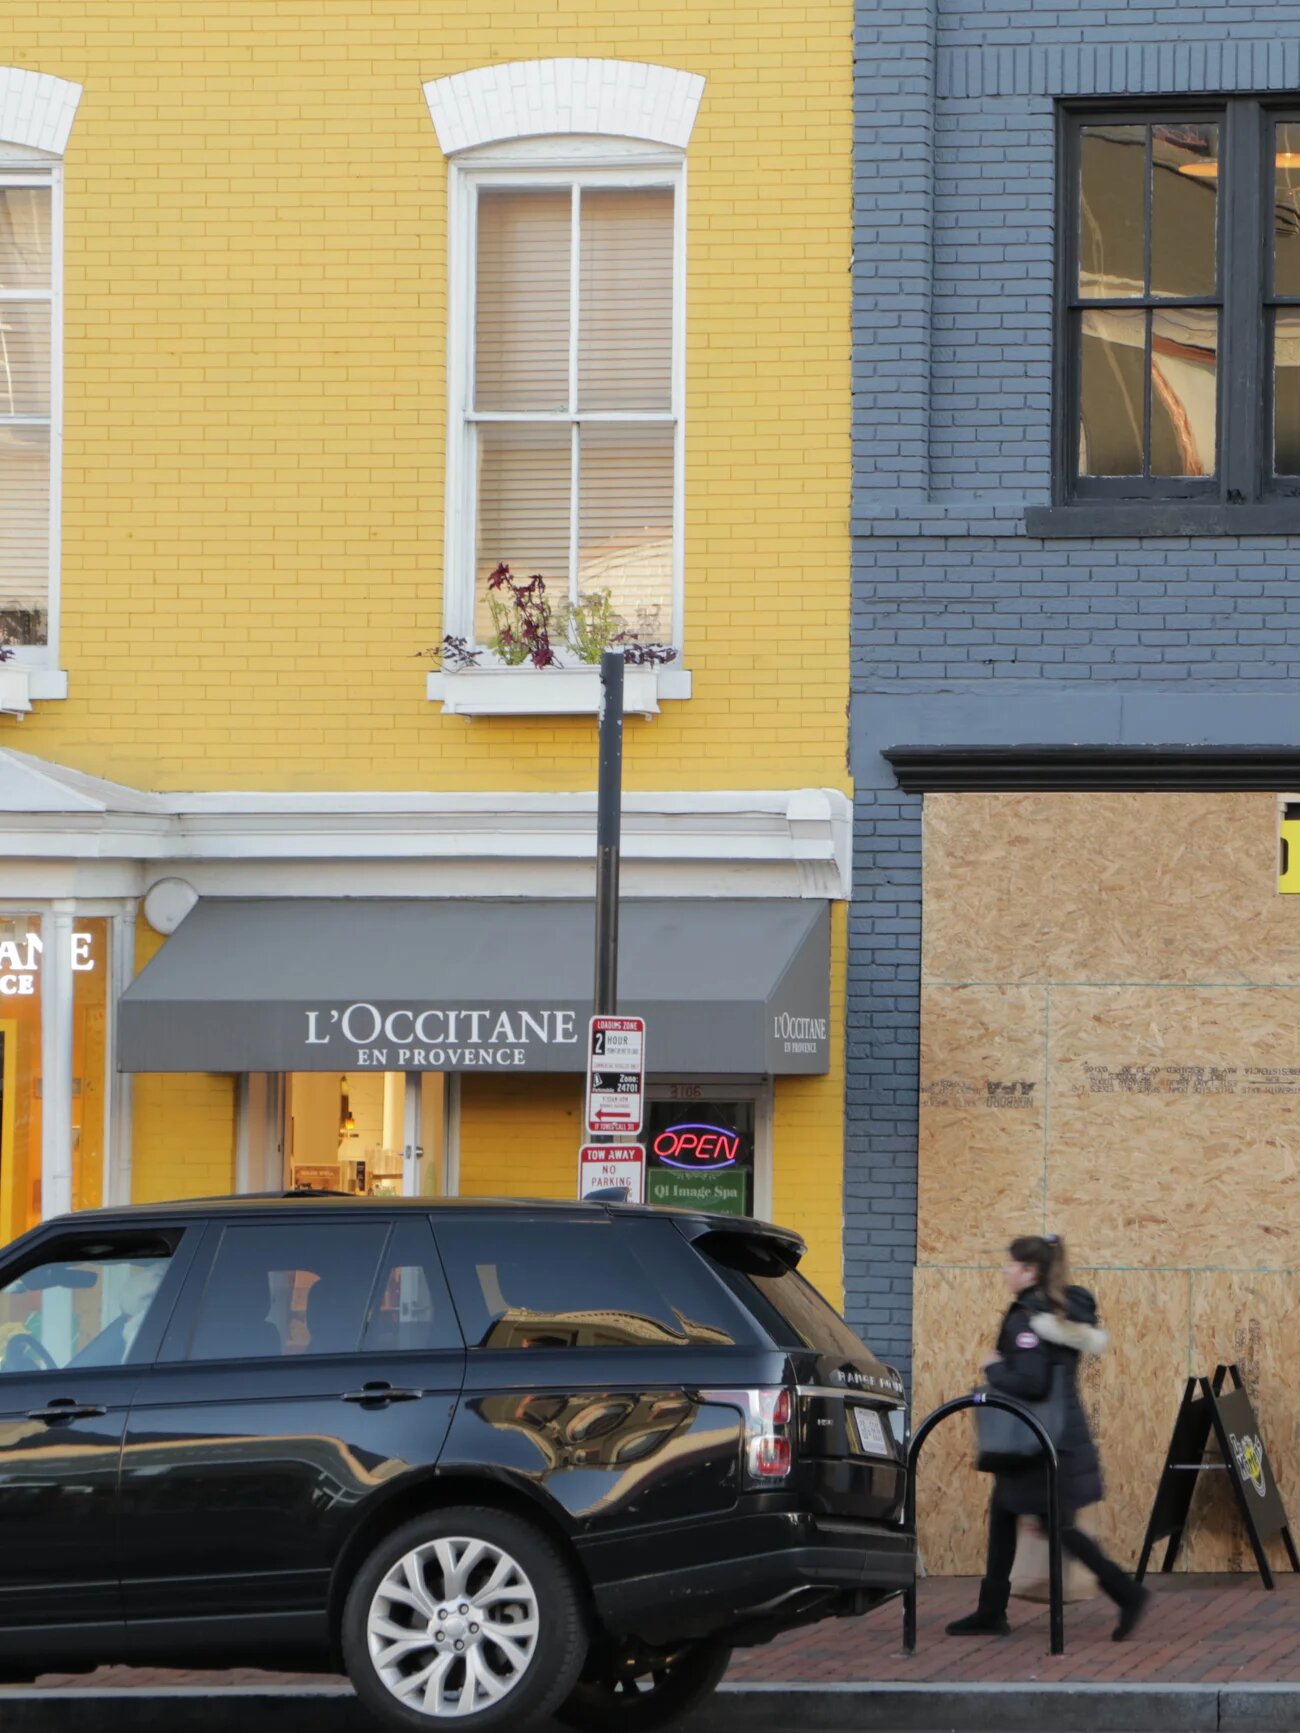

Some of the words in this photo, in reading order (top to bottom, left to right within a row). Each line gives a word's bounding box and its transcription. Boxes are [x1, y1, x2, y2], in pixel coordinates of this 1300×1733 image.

[305, 1003, 578, 1044] L'OCCITANE
[597, 1020, 621, 1030] LOADING
[623, 1021, 637, 1030] ZONE
[595, 1032, 603, 1054] 2
[607, 1035, 628, 1046] HOUR
[357, 1049, 387, 1065] EN
[397, 1049, 526, 1065] PROVENCE
[619, 1073, 639, 1083] Zone:
[616, 1083, 638, 1092] 24701
[670, 1085, 701, 1098] 3106
[653, 1132, 740, 1160] OPEN
[587, 1150, 605, 1160] TOW
[608, 1150, 636, 1160] AWAY
[602, 1164, 616, 1175] NO
[591, 1176, 632, 1187] PARKING
[673, 1184, 711, 1199] Image
[714, 1184, 738, 1200] Spa
[838, 1371, 875, 1386] RANGE
